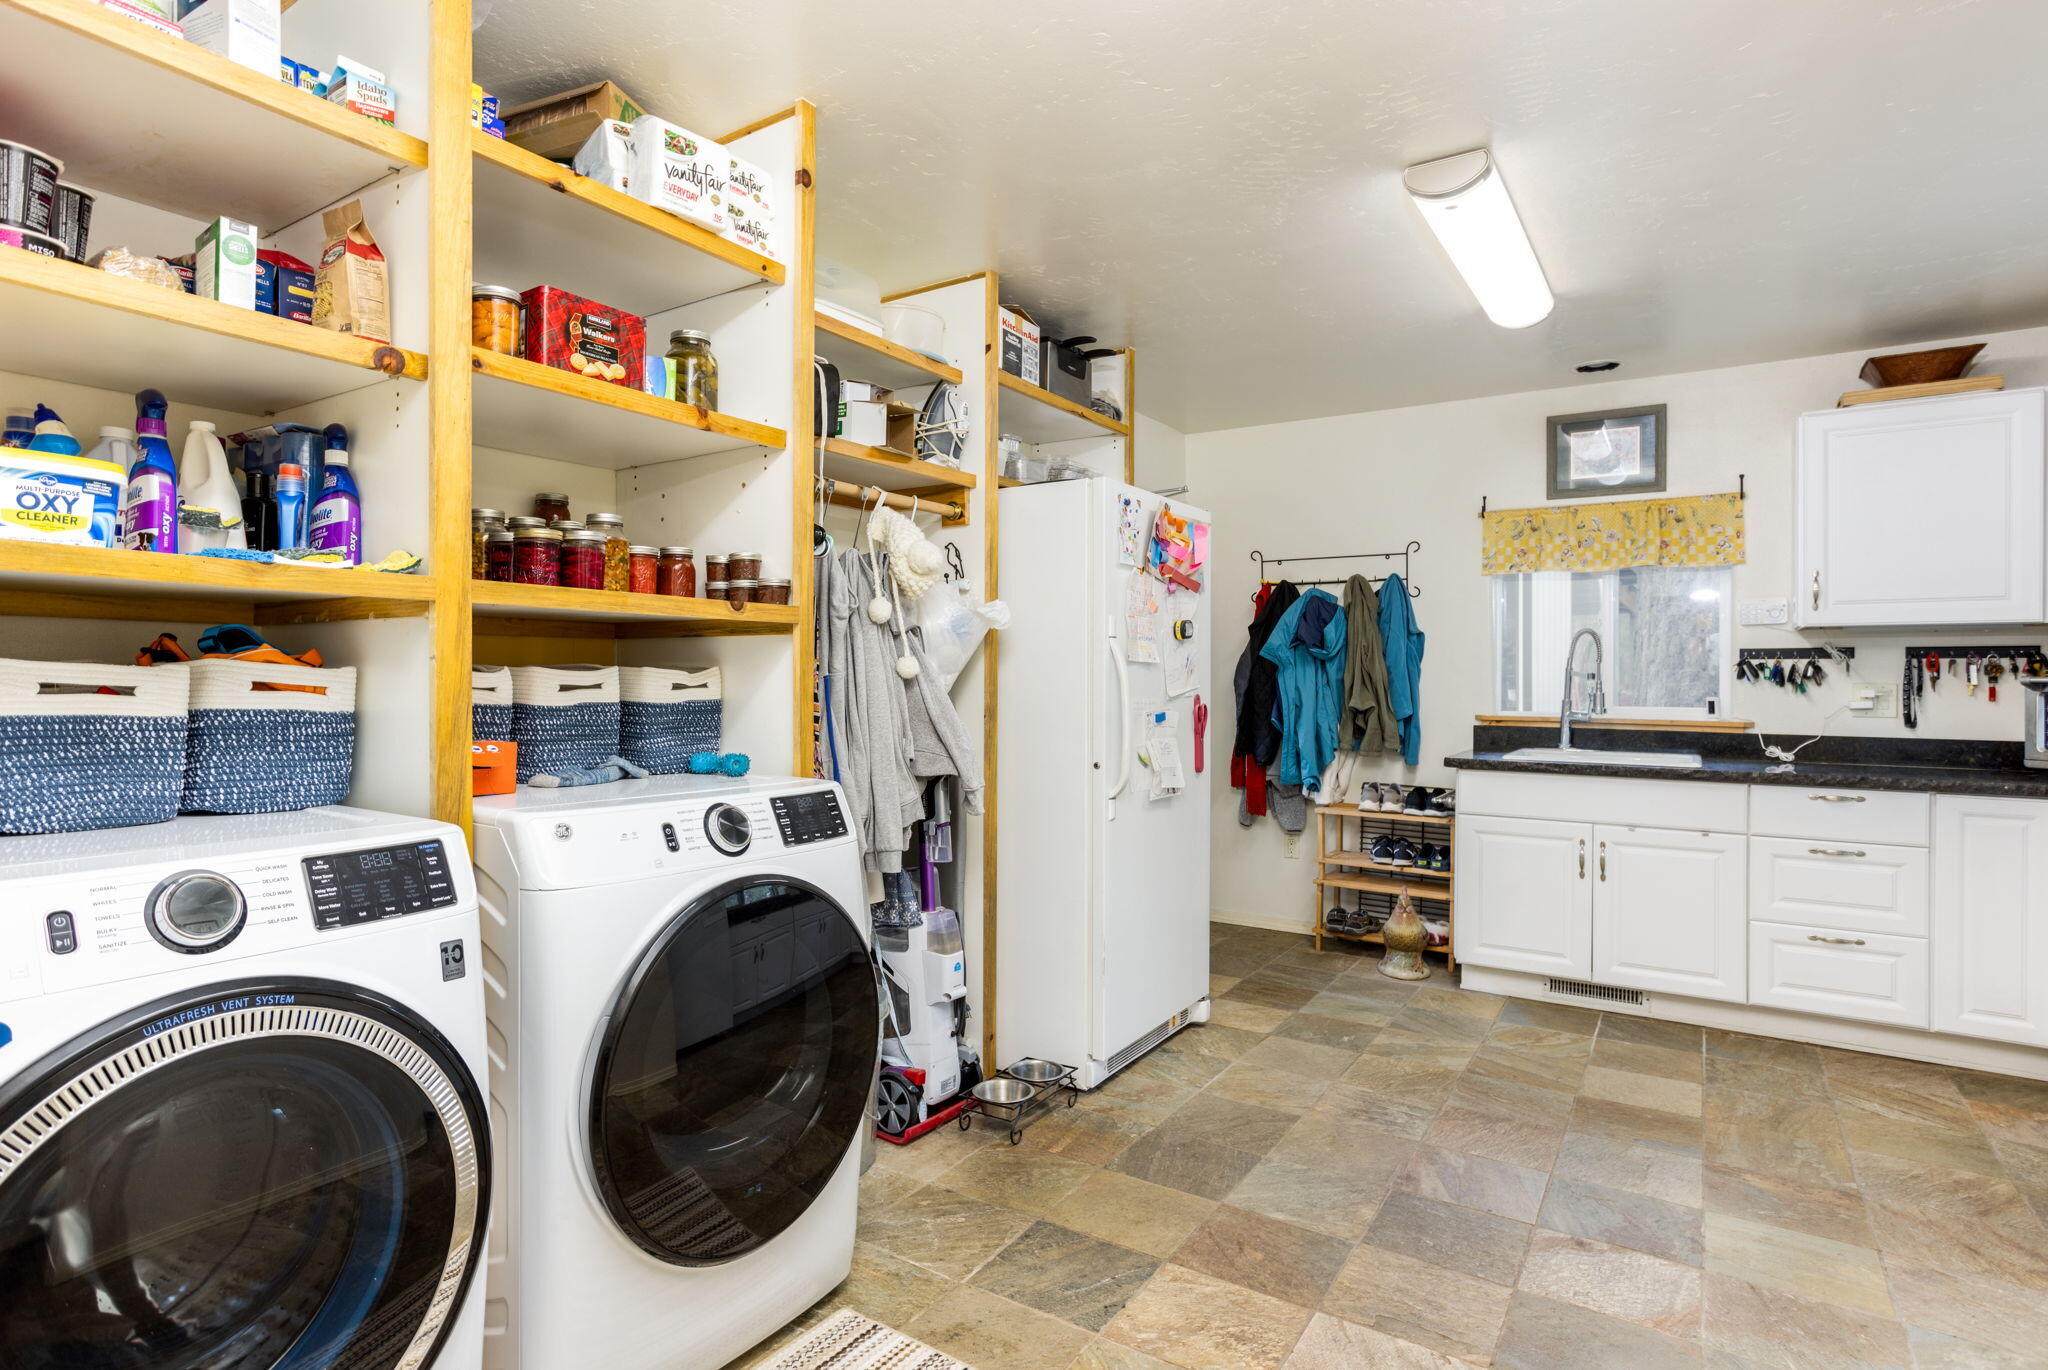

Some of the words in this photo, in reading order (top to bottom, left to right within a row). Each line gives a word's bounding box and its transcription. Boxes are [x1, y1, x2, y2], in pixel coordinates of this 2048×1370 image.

[357, 80, 388, 97] Idaho
[356, 90, 388, 106] Spuds
[664, 181, 699, 202] EVERYDAY
[28, 243, 55, 258] MISO
[582, 327, 615, 343] Walkers
[1002, 318, 1038, 344] KitcnAid
[16, 484, 80, 498] MULTI-PURPOSE
[16, 491, 80, 514] OXY
[16, 511, 78, 526] CLEANER
[94, 914, 120, 922] TOWELS
[98, 941, 127, 949] SANITIZE
[142, 1004, 216, 1037] ULTRAFRESH
[221, 997, 250, 1010] VENT
[255, 994, 296, 1006] SYSTEM
